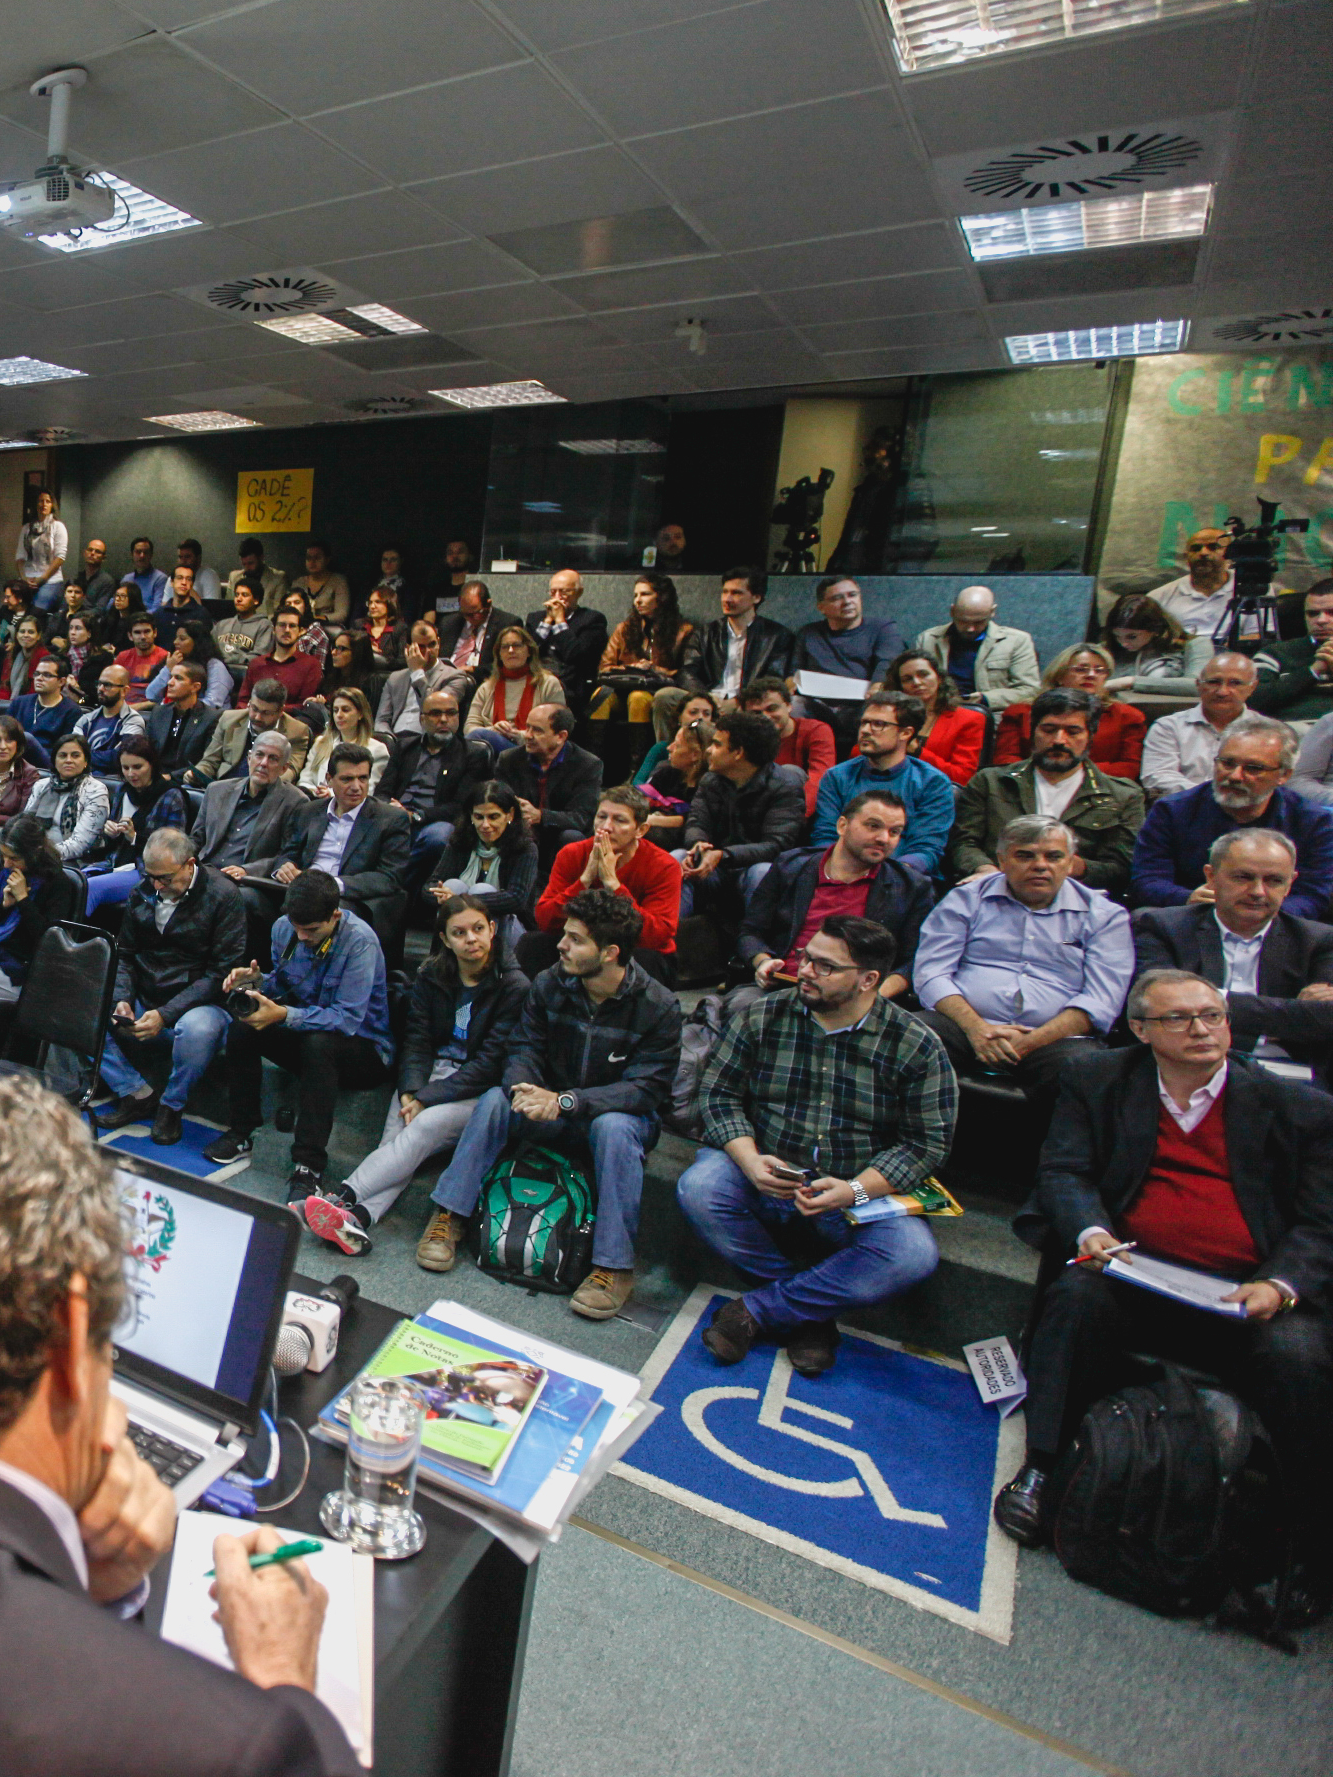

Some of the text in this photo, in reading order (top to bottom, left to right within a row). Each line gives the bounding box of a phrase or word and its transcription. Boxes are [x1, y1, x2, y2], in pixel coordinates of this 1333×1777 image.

[246, 474, 292, 498] CADÊ
[247, 501, 266, 523] OS
[405, 1343, 454, 1365] de Notas
[410, 1336, 459, 1359] Caderno
[973, 1348, 1002, 1395] AUTORIDADES
[990, 1346, 1016, 1387] RESERVADO
